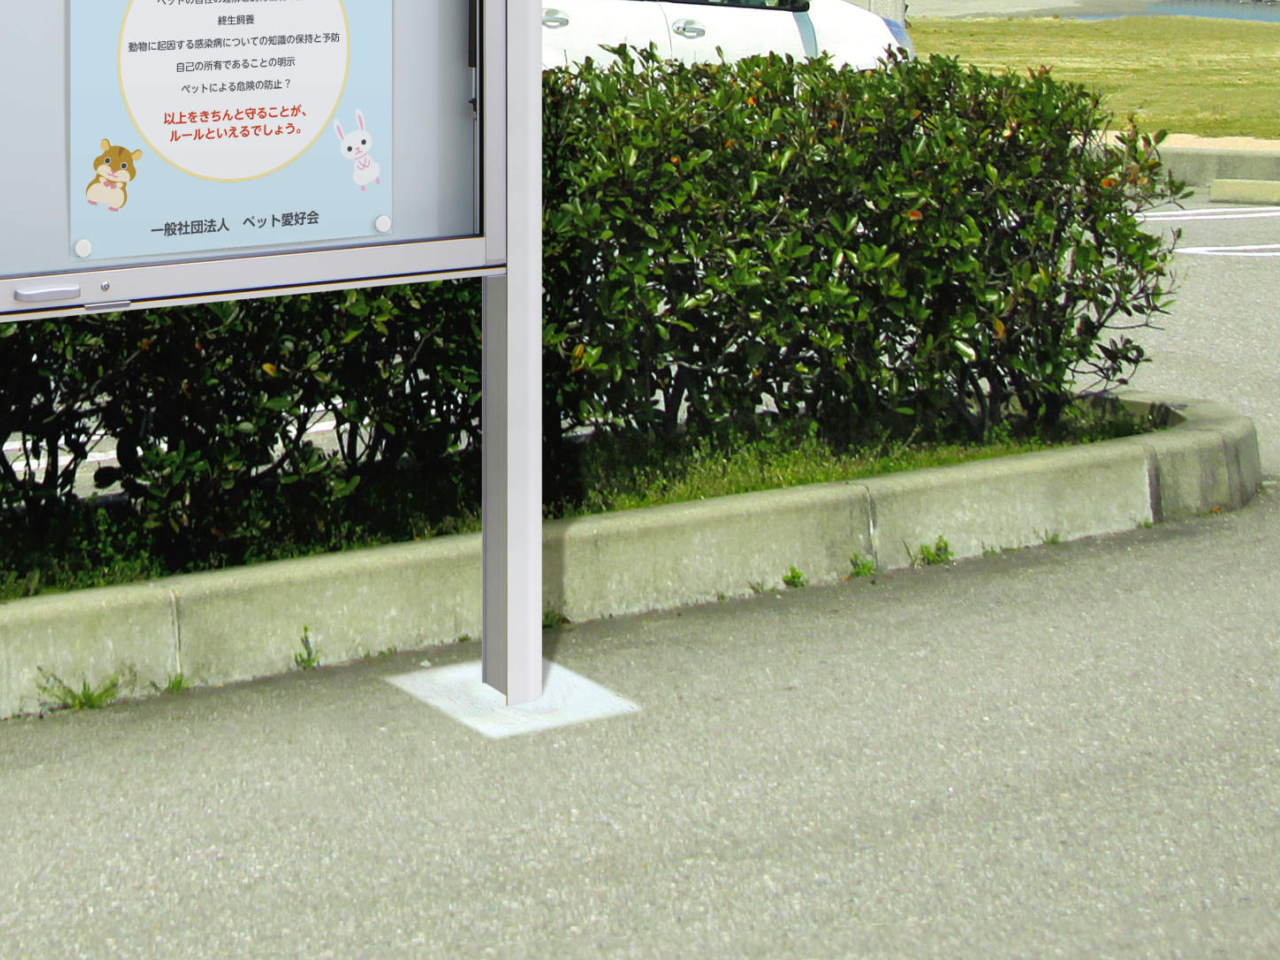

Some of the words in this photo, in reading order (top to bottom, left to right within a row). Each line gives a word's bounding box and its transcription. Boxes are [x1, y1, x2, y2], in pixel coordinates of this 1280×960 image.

[217, 14, 255, 26] 終生飼養
[128, 32, 340, 52] 動物に起因する感染病についての知識の保持と予防
[176, 56, 296, 73] 自己の所有であることの明示
[163, 104, 307, 125] 以上をきちんと守ることが、
[169, 123, 301, 142] ルールといえるでしょう。
[150, 217, 230, 237] 一般社団法人
[242, 210, 320, 229] ペット愛好会
